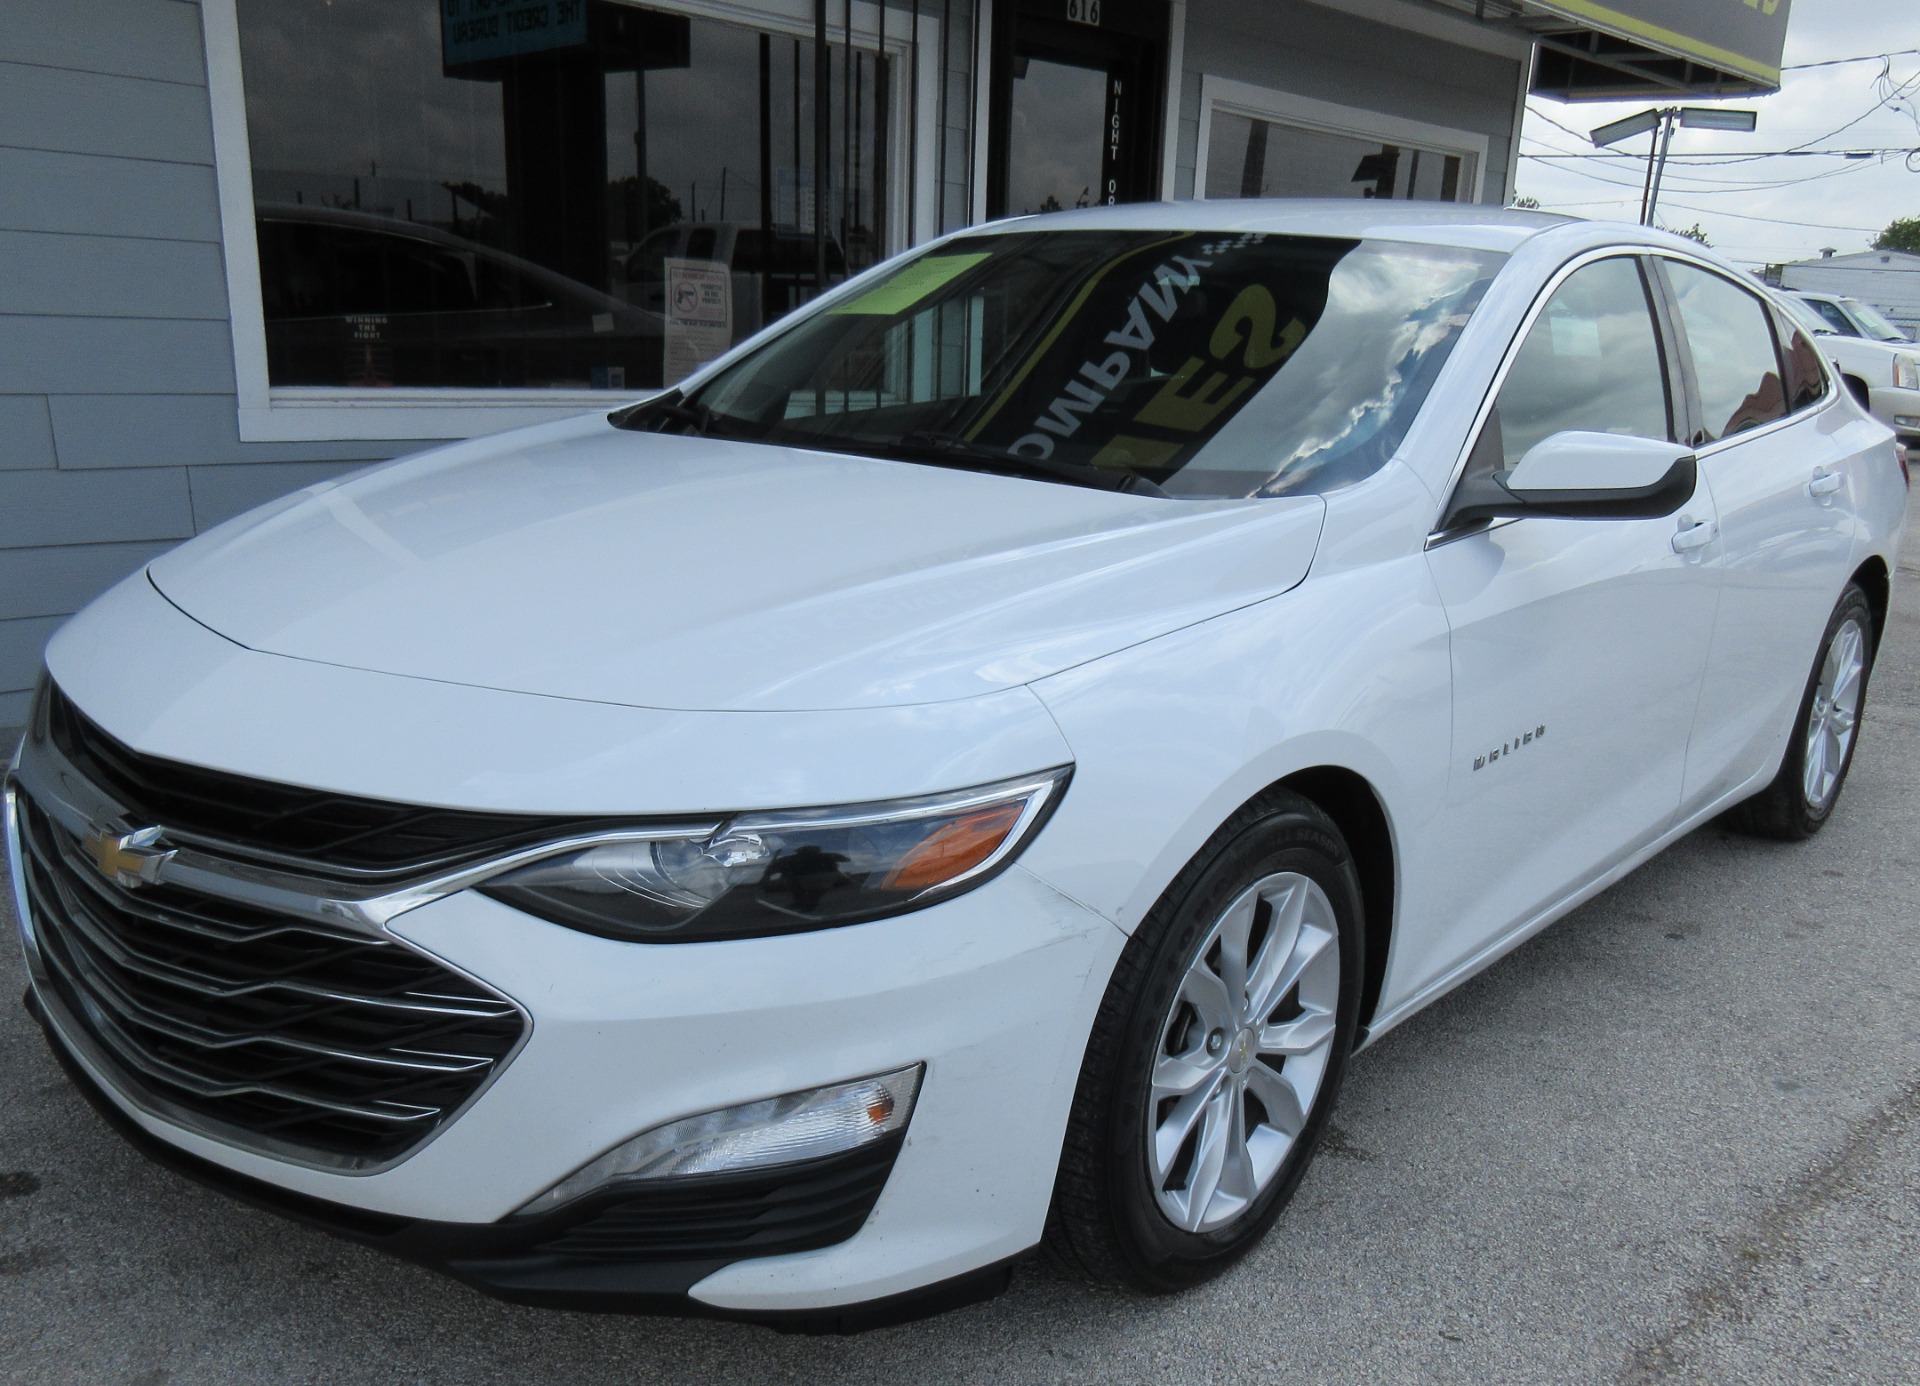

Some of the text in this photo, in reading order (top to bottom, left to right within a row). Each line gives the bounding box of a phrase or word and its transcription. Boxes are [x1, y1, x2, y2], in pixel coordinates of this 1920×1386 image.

[1069, 0, 1098, 23] 616
[1111, 80, 1122, 161] NIGHT
[345, 315, 388, 324] WINNING
[1473, 722, 1546, 772] MALIBU
[1296, 828, 1341, 857] SEASON
